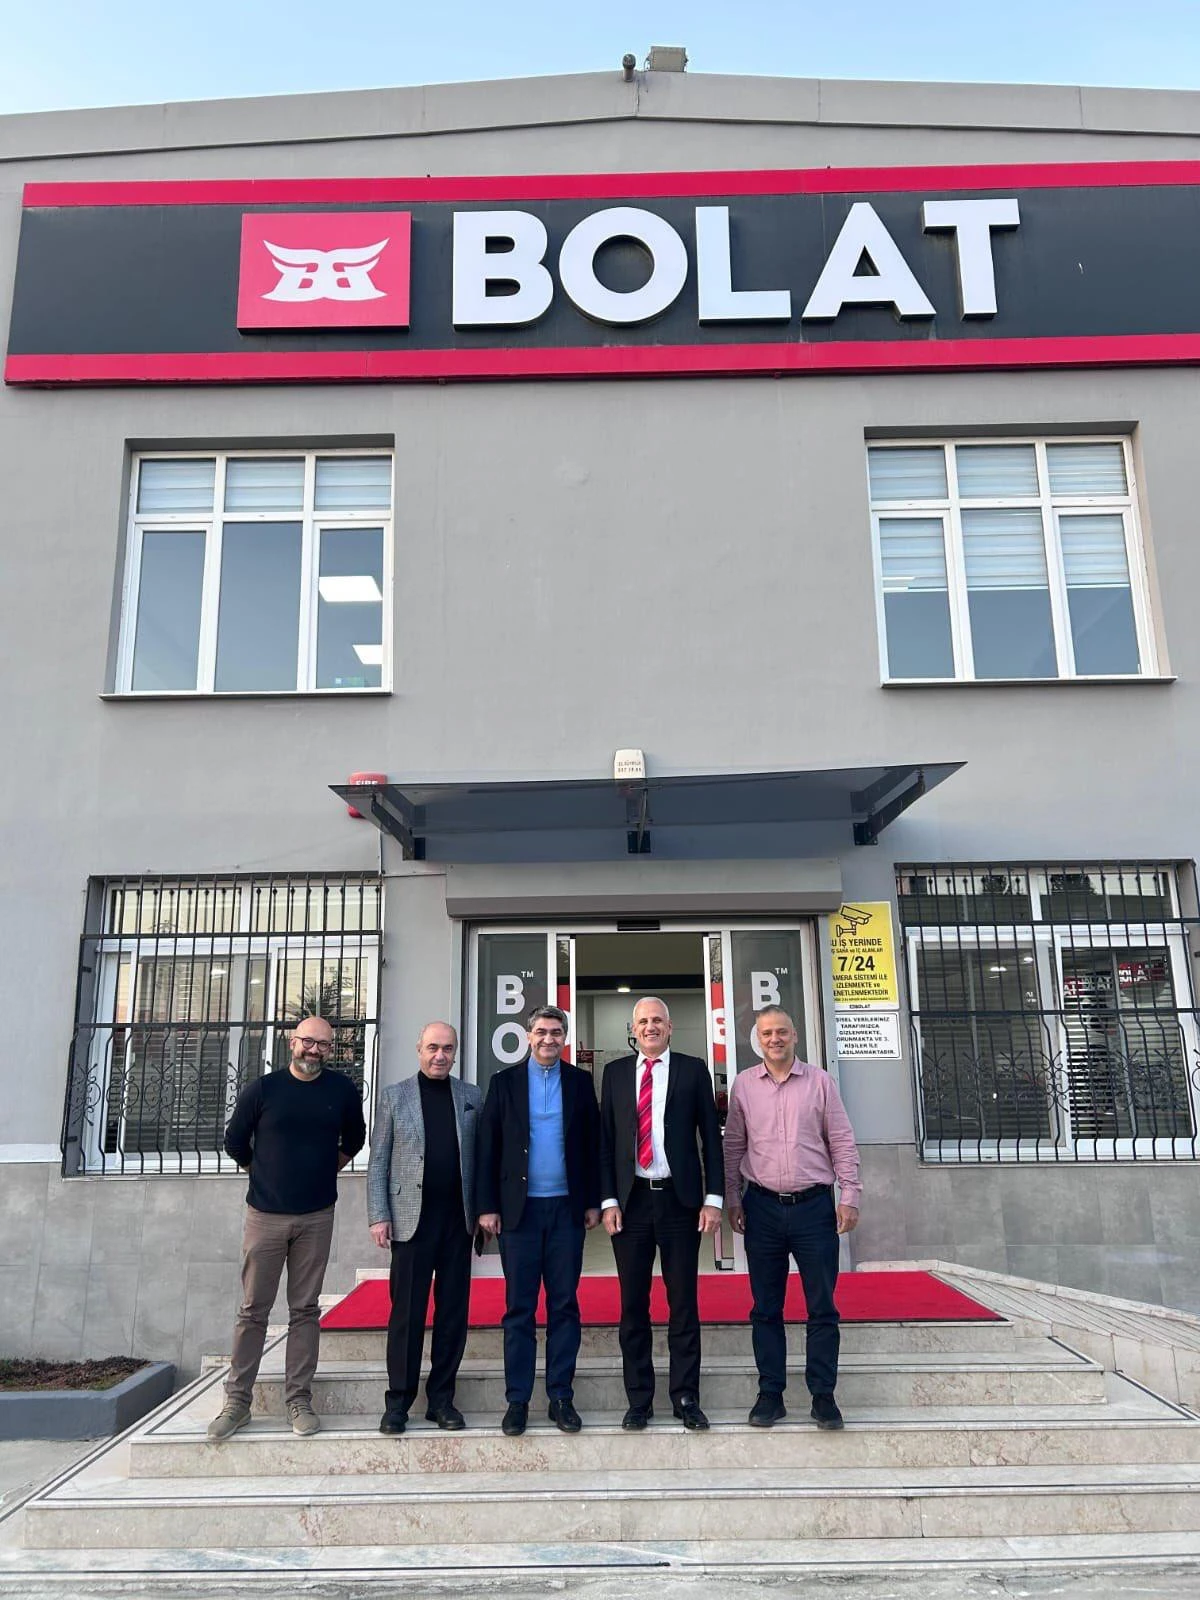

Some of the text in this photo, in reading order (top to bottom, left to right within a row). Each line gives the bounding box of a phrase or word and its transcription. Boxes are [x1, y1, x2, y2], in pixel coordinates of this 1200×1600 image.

[452, 198, 1020, 331] BOLAT
[848, 938, 882, 946] YERİNDE
[838, 955, 876, 972] 7/24
